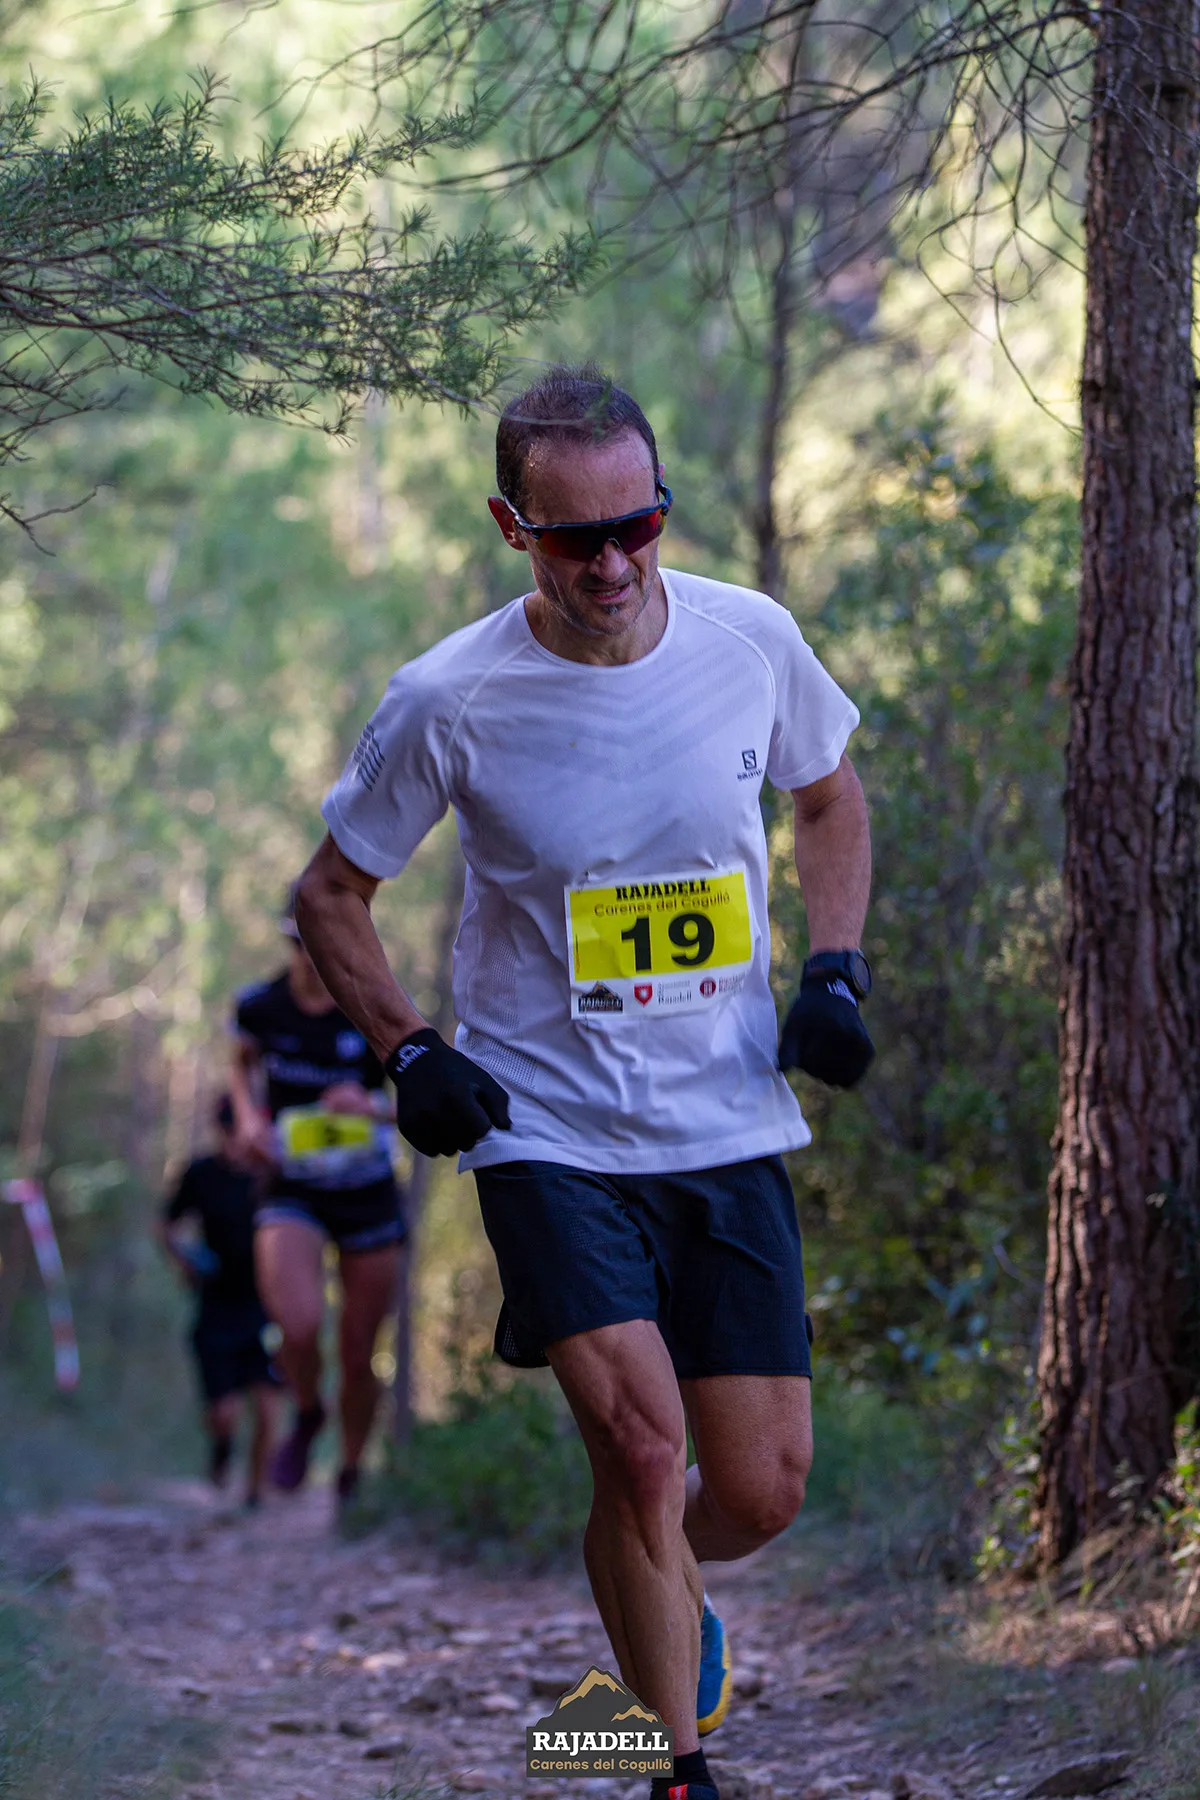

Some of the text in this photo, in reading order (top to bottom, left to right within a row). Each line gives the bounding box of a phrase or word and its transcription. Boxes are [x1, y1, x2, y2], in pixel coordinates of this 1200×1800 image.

[615, 879, 711, 900] RAJADELL
[594, 903, 652, 917] Carenes
[656, 898, 678, 912] del
[620, 912, 715, 973] 19
